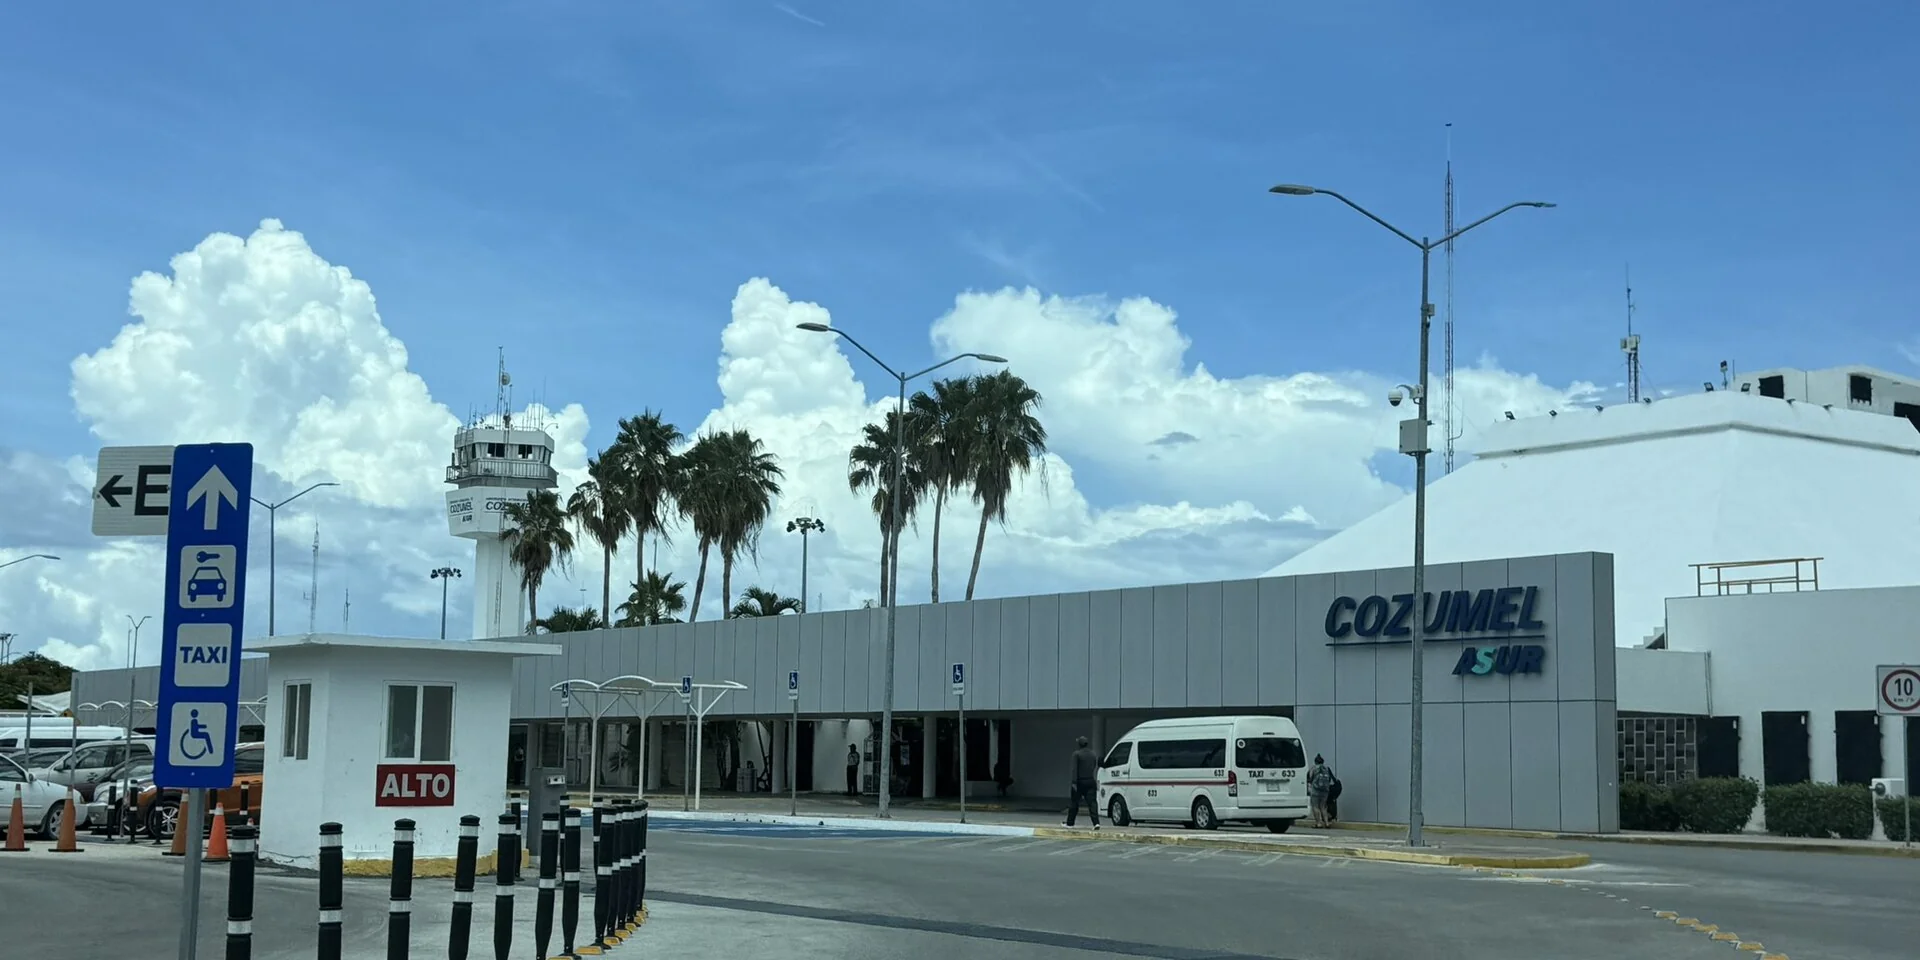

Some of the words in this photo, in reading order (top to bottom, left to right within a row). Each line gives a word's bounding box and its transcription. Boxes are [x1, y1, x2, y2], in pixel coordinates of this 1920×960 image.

[1325, 586, 1544, 638] COZUMEL
[179, 646, 228, 664] TAXI
[1451, 645, 1545, 676] ASUR
[1894, 678, 1913, 696] 10
[1214, 769, 1224, 777] 633
[1248, 770, 1264, 778] TAXI
[1281, 770, 1296, 778] 633
[380, 773, 451, 798] ALTO
[1148, 789, 1158, 797] 633
